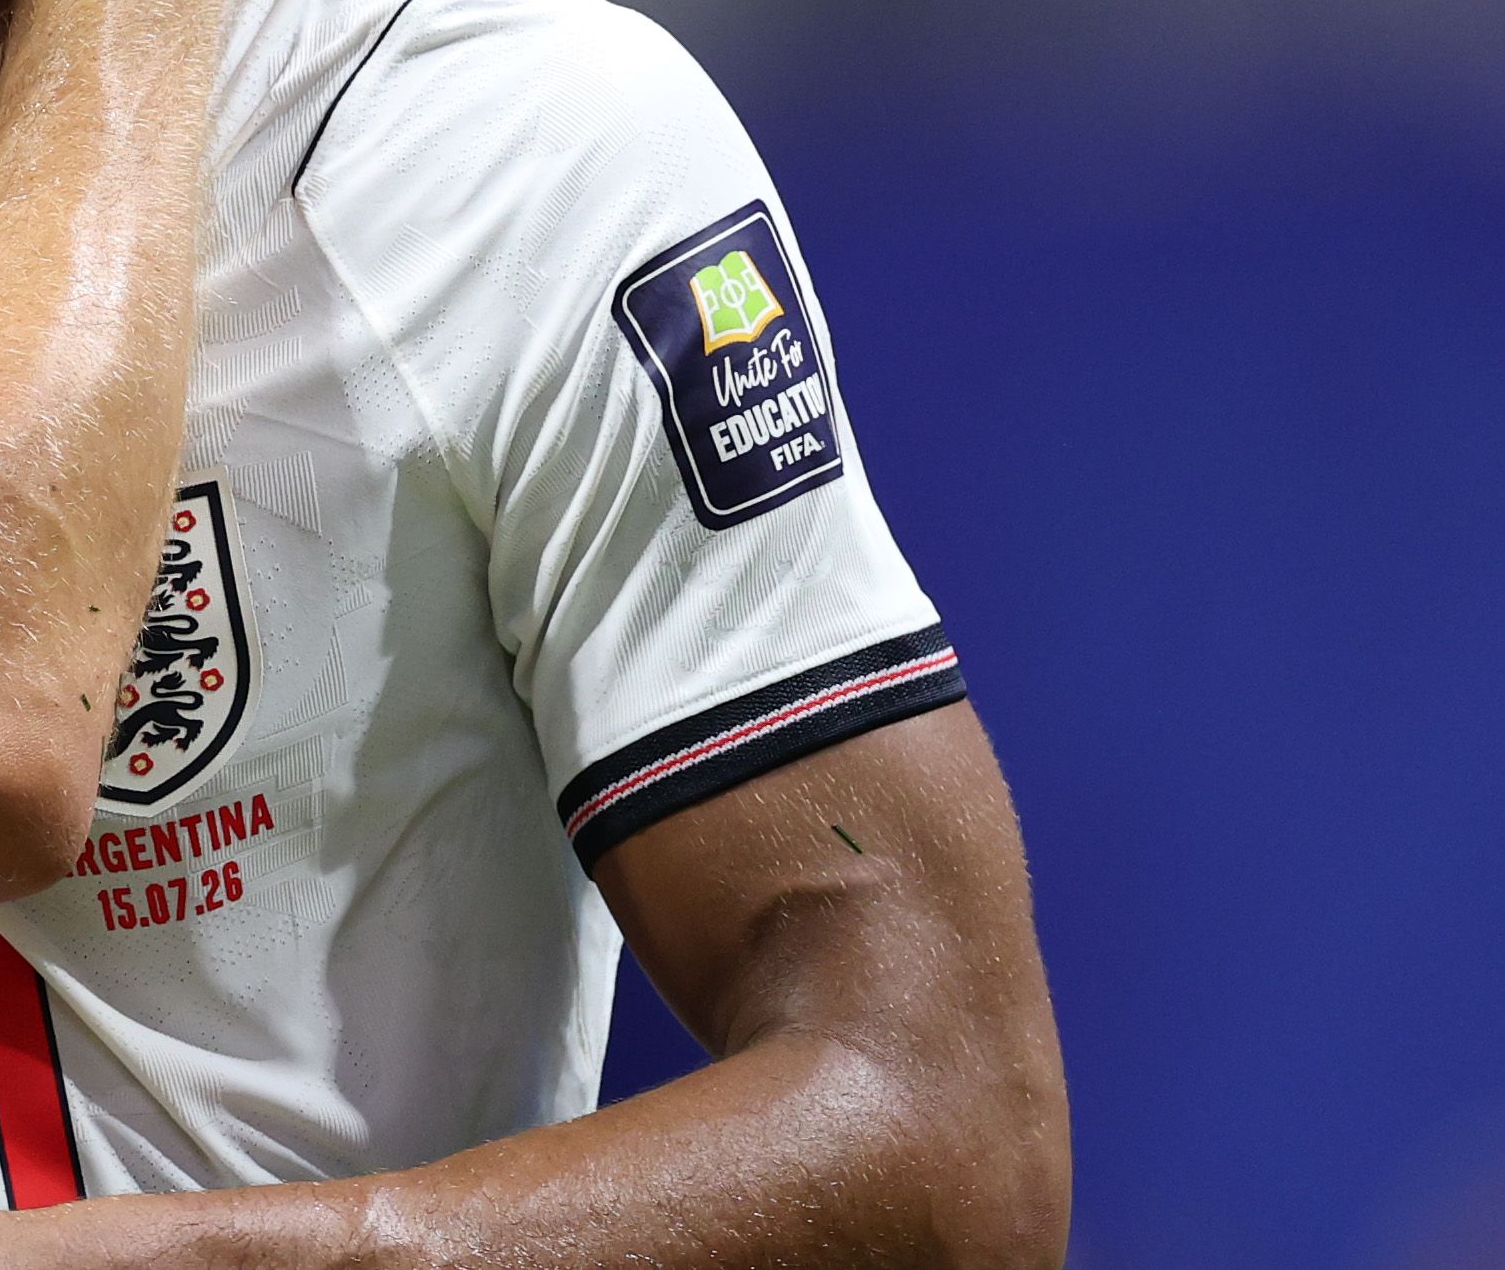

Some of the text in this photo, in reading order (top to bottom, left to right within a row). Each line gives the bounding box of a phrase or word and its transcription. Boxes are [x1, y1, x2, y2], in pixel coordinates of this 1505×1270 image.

[712, 328, 804, 407] Unite For
[770, 433, 823, 471] FIFA
[66, 793, 275, 878] RGENTINA
[97, 860, 244, 931] 15.07.26
